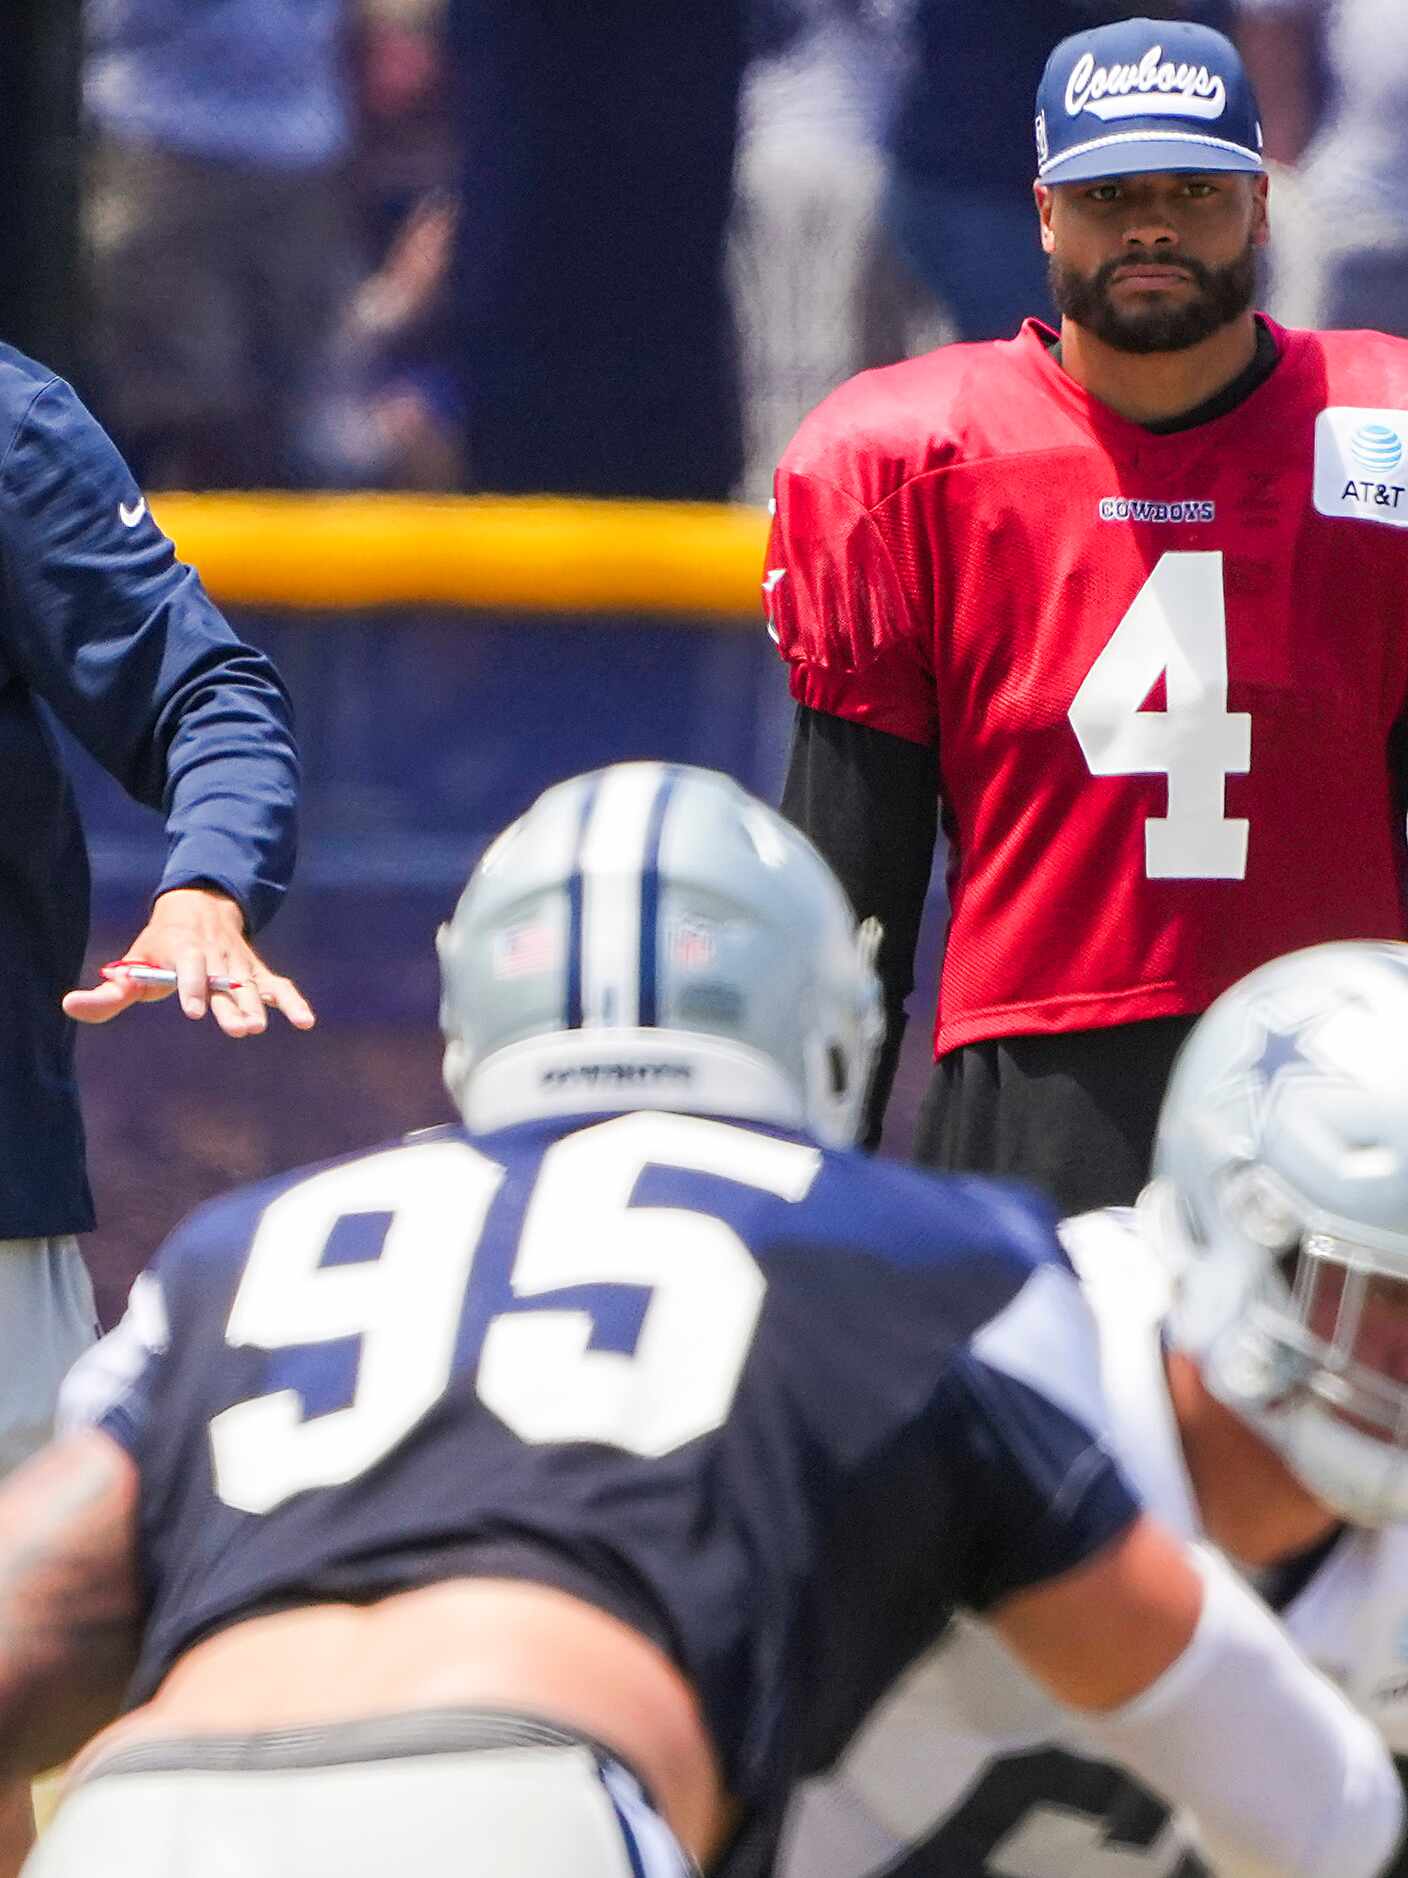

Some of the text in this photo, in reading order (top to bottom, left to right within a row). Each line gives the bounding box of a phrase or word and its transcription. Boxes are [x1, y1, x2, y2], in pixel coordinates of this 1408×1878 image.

[1065, 45, 1226, 121] Cowboys
[1099, 497, 1215, 523] COWBOYS
[1341, 480, 1405, 508] AT&T
[1067, 550, 1251, 880] 4
[209, 1110, 823, 1515] 95
